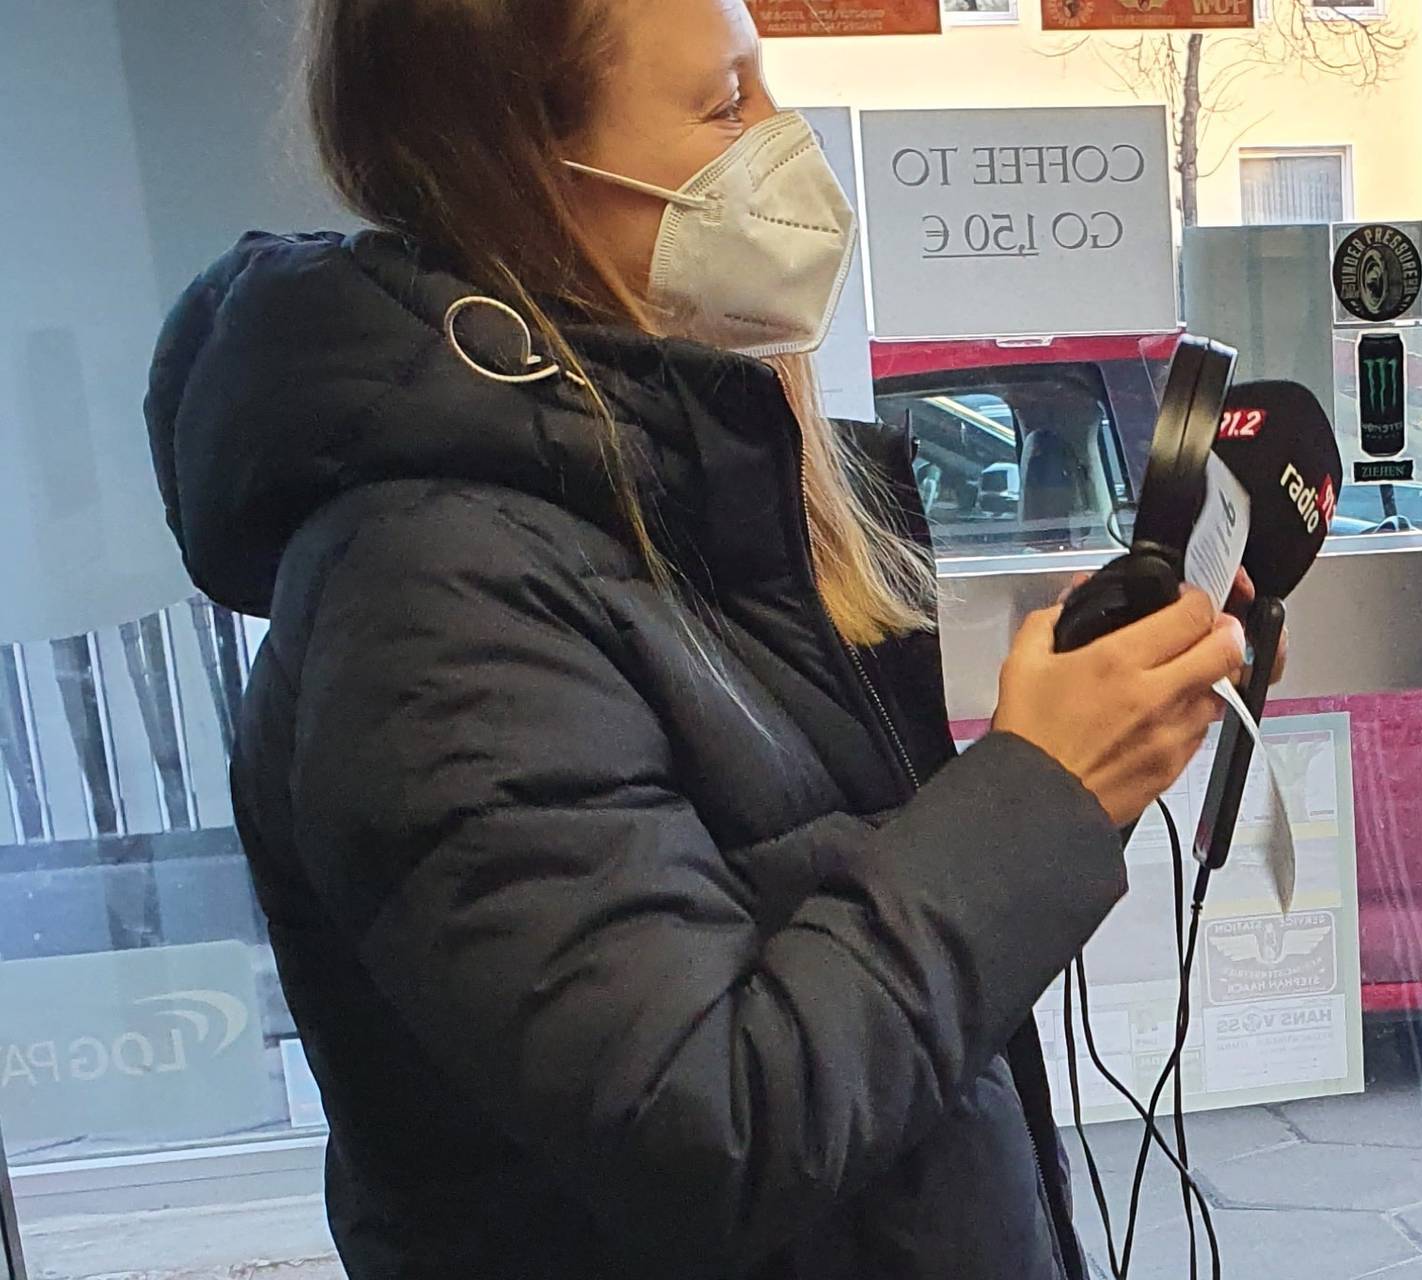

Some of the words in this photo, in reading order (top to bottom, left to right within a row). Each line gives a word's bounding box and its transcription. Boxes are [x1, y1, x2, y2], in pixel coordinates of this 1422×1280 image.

[1341, 238, 1366, 284] UNDER
[1361, 465, 1406, 478] ZIEHEN
[1280, 463, 1320, 533] radio
